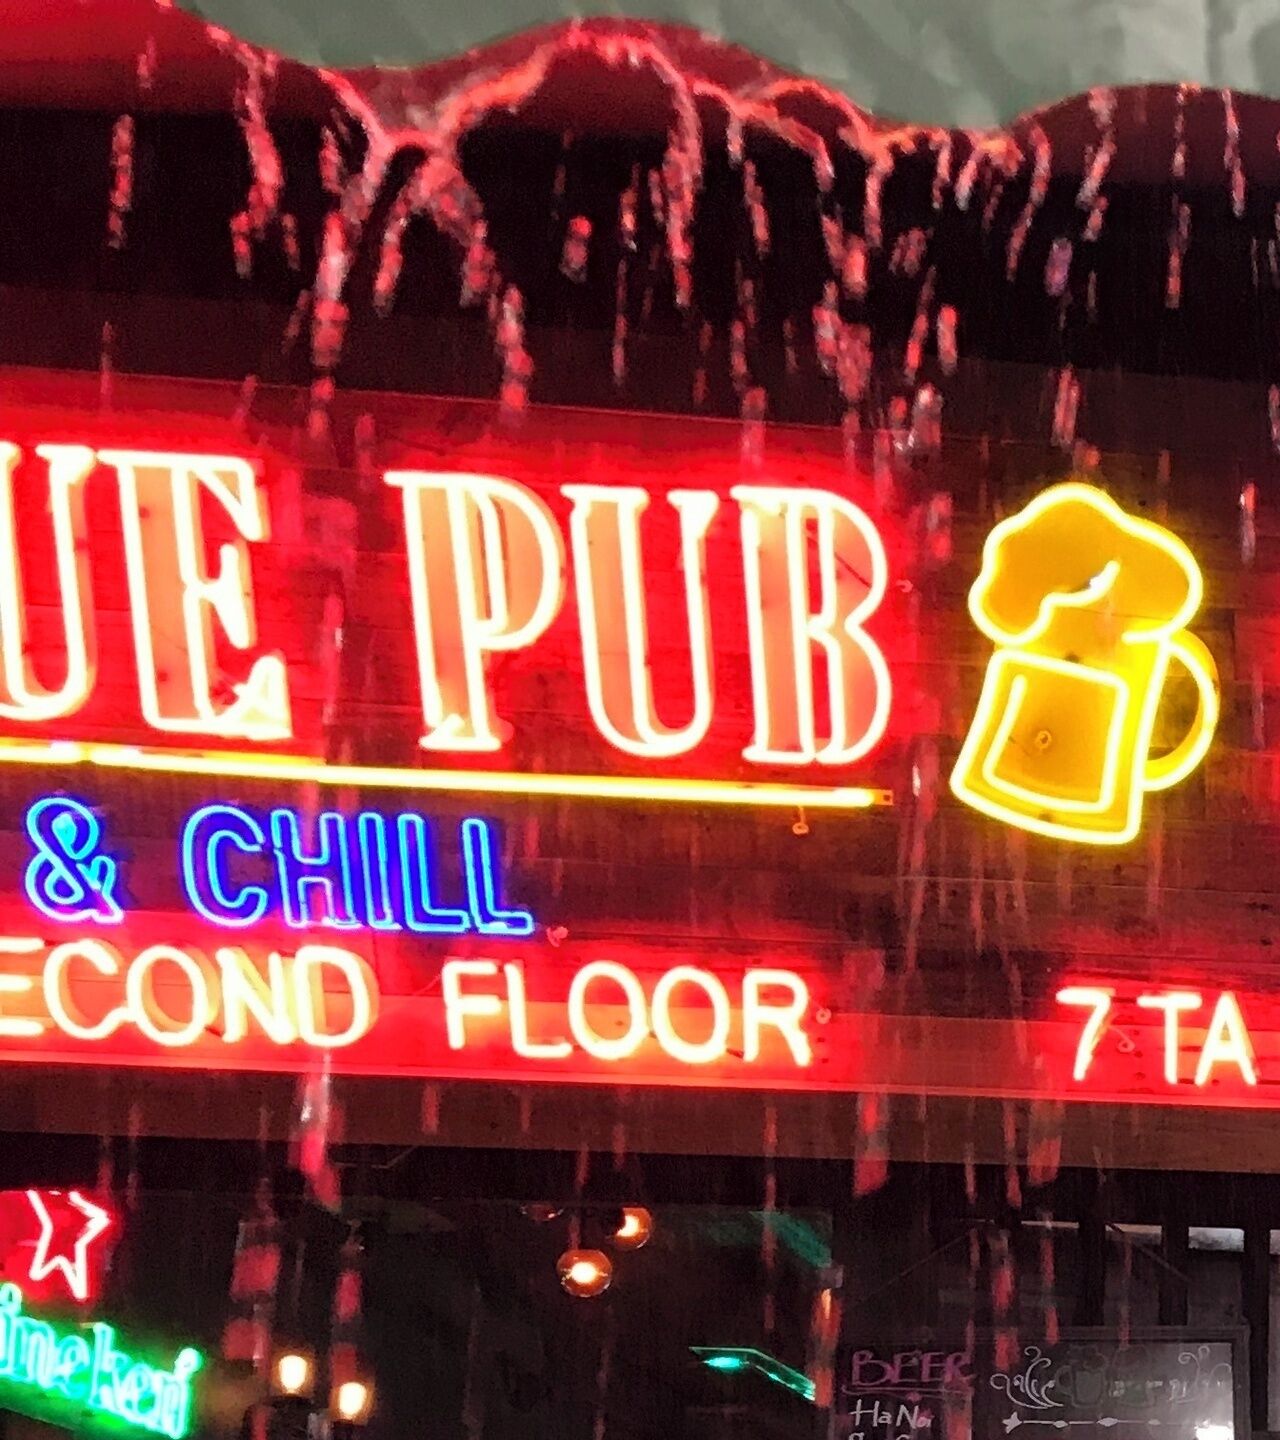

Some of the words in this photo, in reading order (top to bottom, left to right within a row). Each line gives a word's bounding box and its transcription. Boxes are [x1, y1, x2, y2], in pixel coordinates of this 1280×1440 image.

[385, 471, 893, 766] PUB
[25, 794, 123, 923] &
[181, 804, 536, 936] CHILL
[442, 960, 812, 1066] FLOOR
[1056, 988, 1113, 1081] 7
[1138, 993, 1257, 1087] TA
[851, 1349, 975, 1387] BEER
